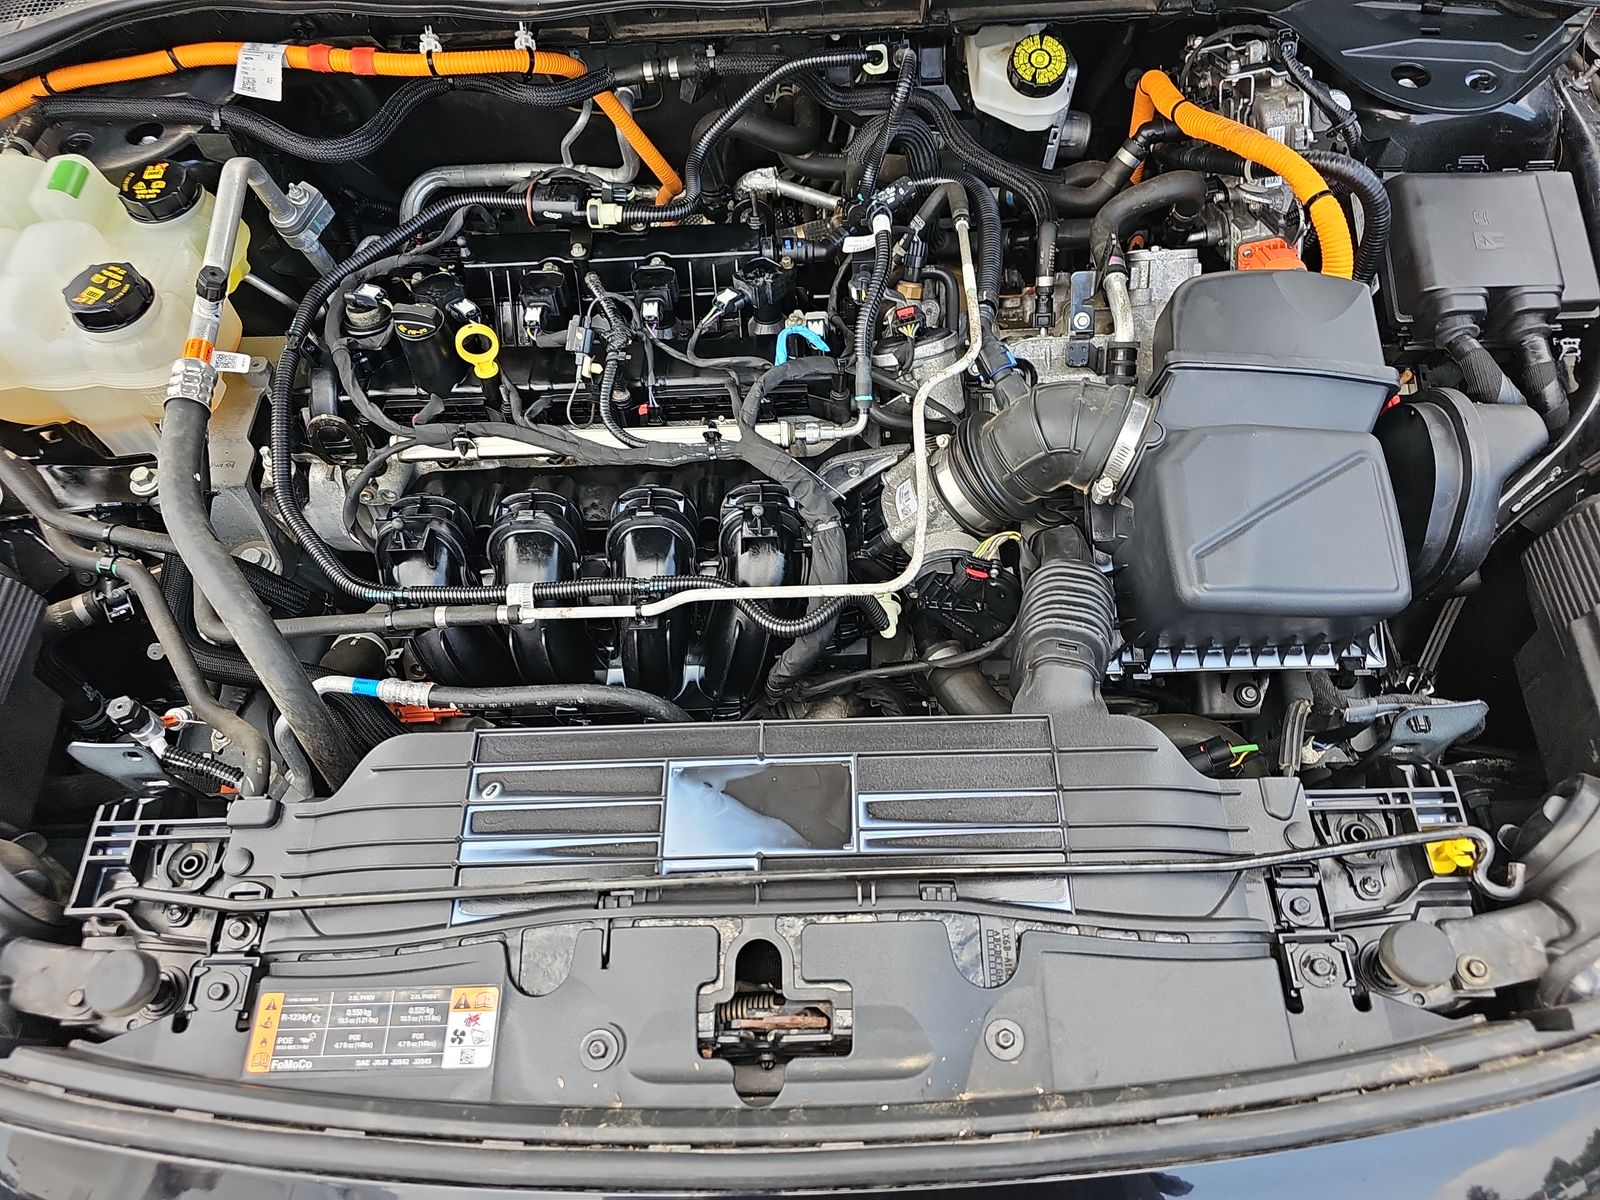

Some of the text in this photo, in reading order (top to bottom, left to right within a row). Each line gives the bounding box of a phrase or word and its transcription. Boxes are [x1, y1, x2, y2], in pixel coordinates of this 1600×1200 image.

[993, 931, 1004, 985] ABCDEFGH
[363, 1008, 372, 1017] kg
[426, 1006, 434, 1015] kg
[281, 1012, 312, 1022] R-1234yf
[276, 1036, 295, 1044] POE
[271, 1058, 313, 1069] FoMoCo
